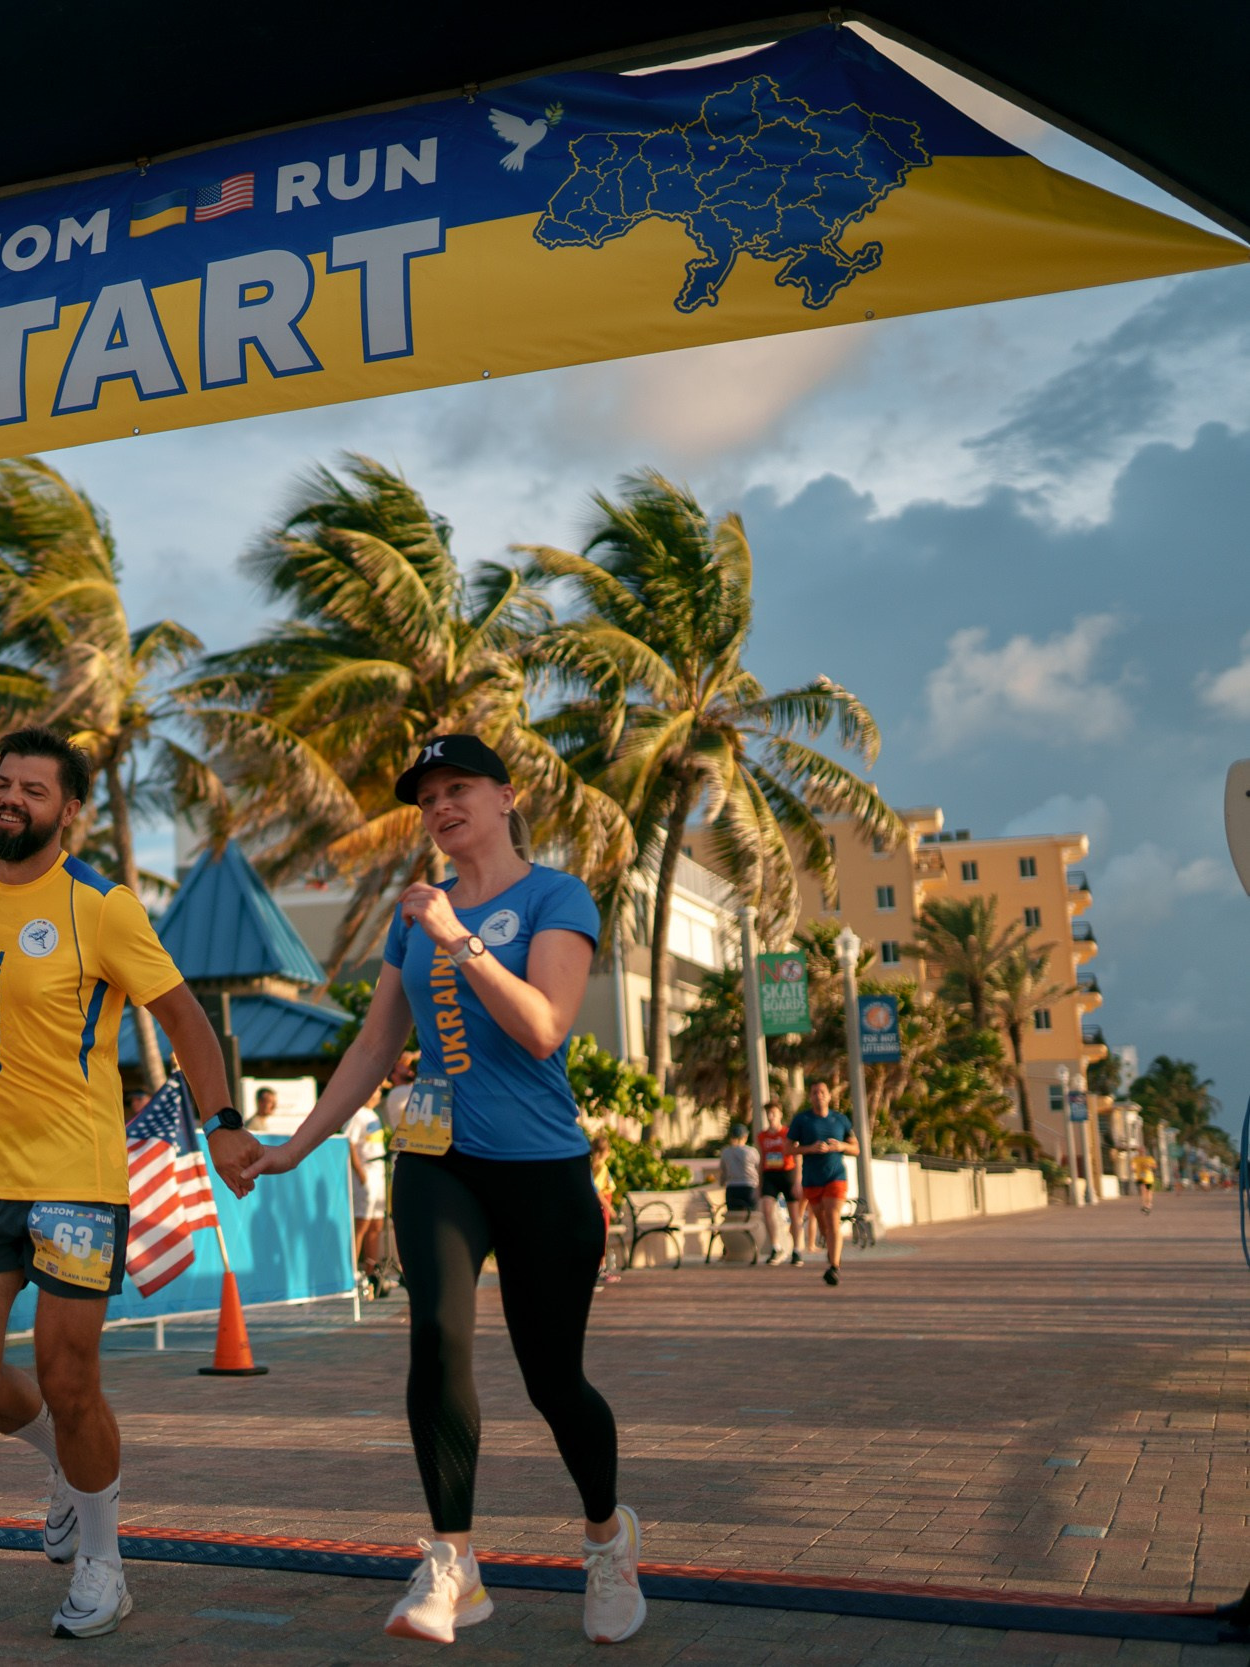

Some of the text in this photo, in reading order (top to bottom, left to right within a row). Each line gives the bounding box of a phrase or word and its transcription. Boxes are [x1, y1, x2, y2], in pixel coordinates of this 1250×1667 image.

[275, 136, 439, 213] RUN
[763, 983, 805, 999] SKATE
[764, 999, 806, 1011] BOARDS
[406, 1091, 433, 1127] 64
[41, 1207, 112, 1224] RAZOM RUN
[53, 1222, 93, 1259] 63
